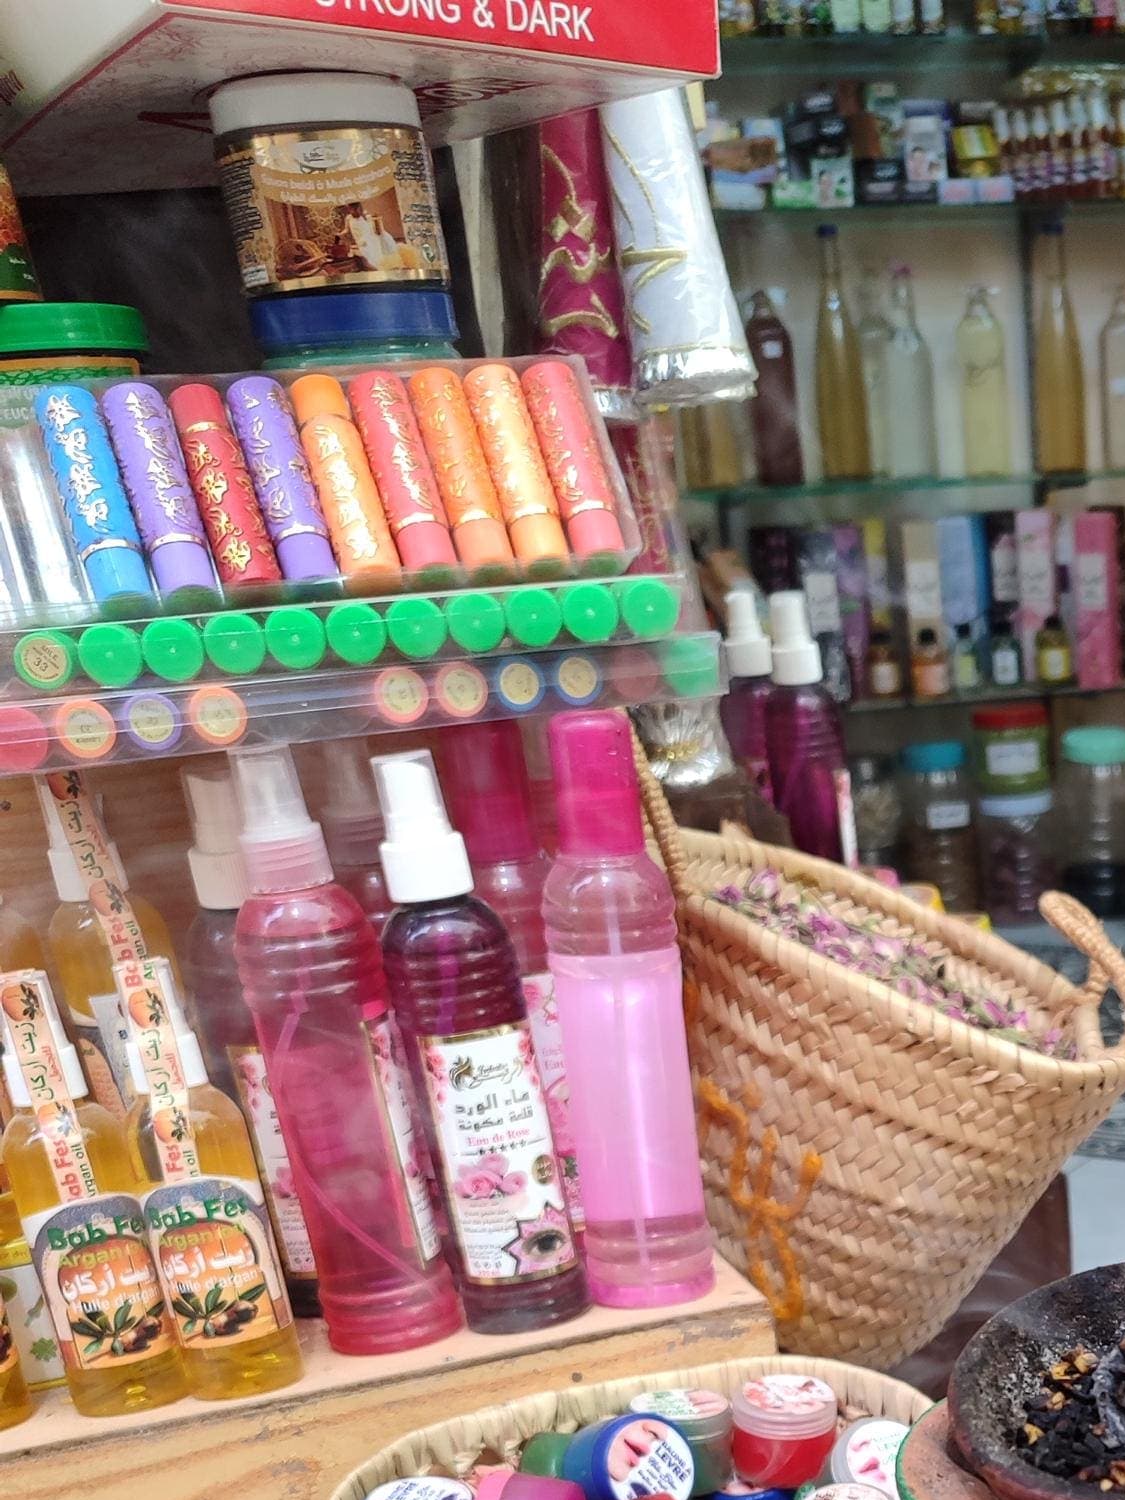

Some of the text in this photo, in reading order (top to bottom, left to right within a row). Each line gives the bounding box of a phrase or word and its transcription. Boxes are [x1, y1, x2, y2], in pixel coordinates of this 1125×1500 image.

[313, 0, 595, 42] ONG & DARK
[60, 801, 82, 833] زيت
[15, 1022, 37, 1054] زيت
[141, 1029, 161, 1061] زيت
[454, 1089, 530, 1115] ماء الورد
[70, 1143, 85, 1158] oil
[165, 1143, 184, 1173] Fes
[182, 1150, 196, 1166] oil
[53, 1139, 81, 1201] ab Fes
[147, 1197, 249, 1230] Bab Fes
[46, 1223, 109, 1251] Bab
[158, 1229, 216, 1250] Argan
[58, 1246, 125, 1269] Argan
[206, 1269, 259, 1290] d'argan
[71, 1297, 112, 1314] Huile
[655, 1447, 686, 1481] LEVRE
